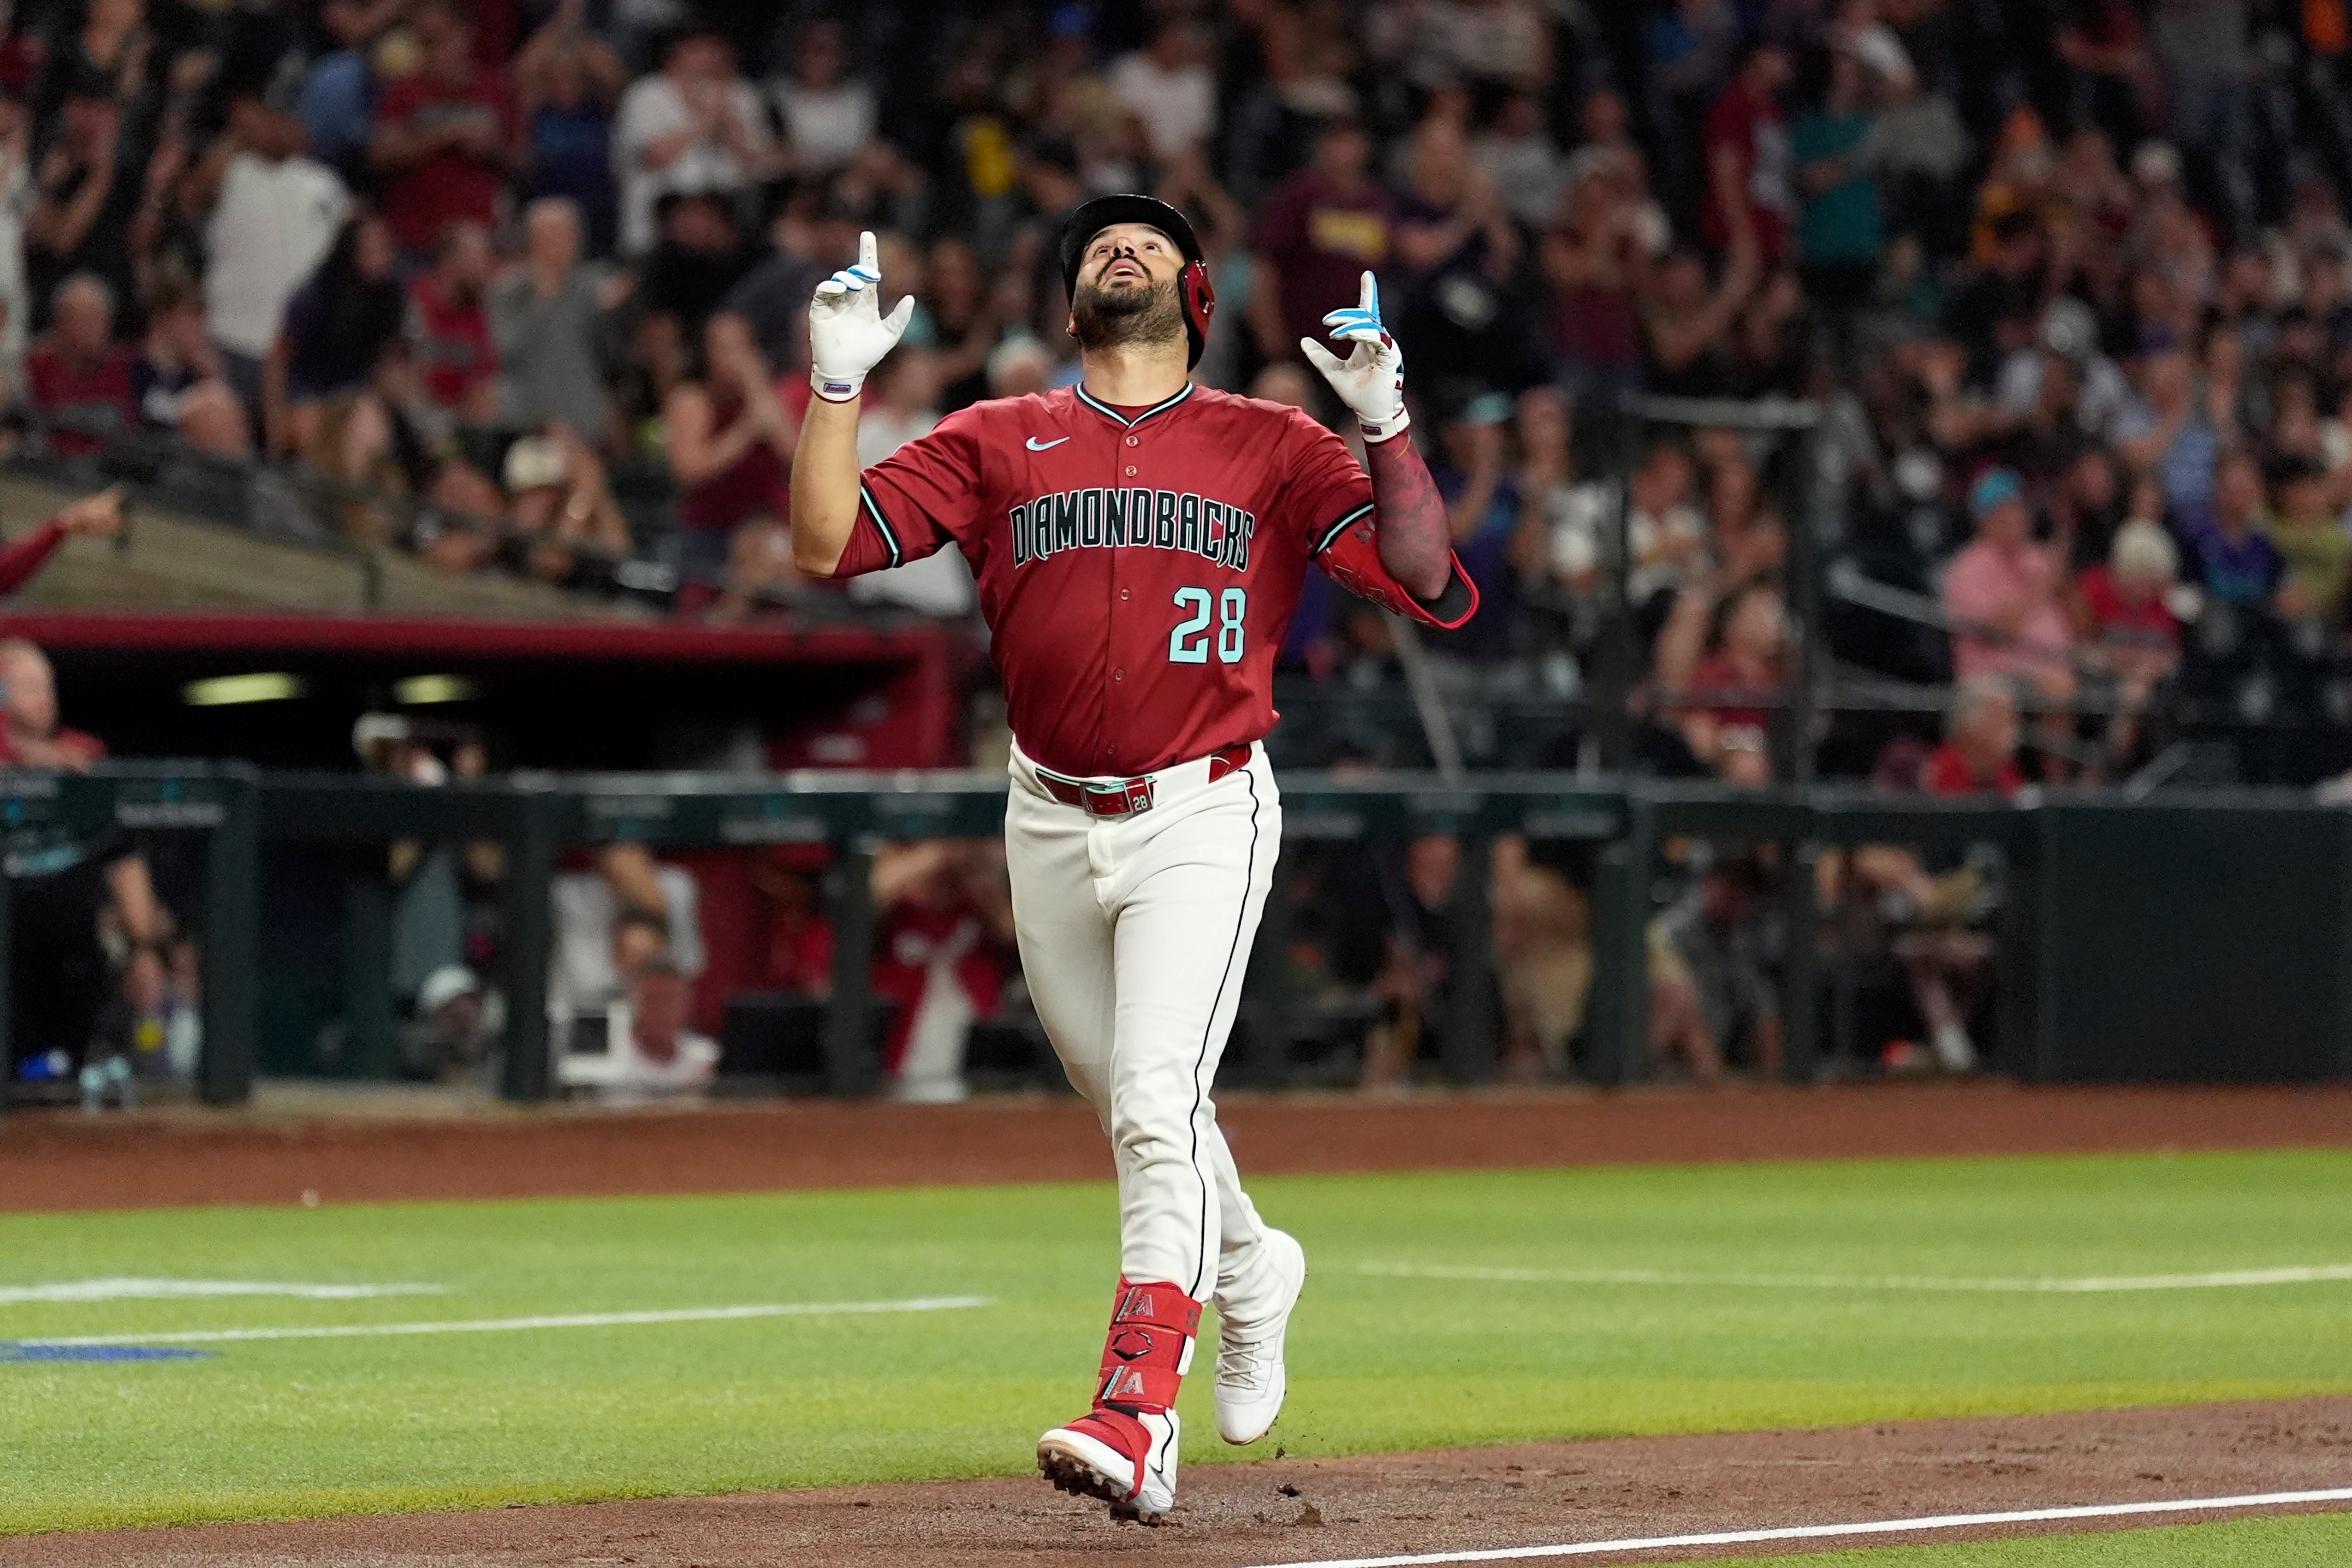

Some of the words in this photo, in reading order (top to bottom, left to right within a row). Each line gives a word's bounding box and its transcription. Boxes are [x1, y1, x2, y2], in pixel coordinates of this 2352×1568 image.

[1009, 487, 1255, 572] DIAMONDBACKS
[1169, 586, 1247, 664] 28
[1133, 794, 1148, 811] 28
